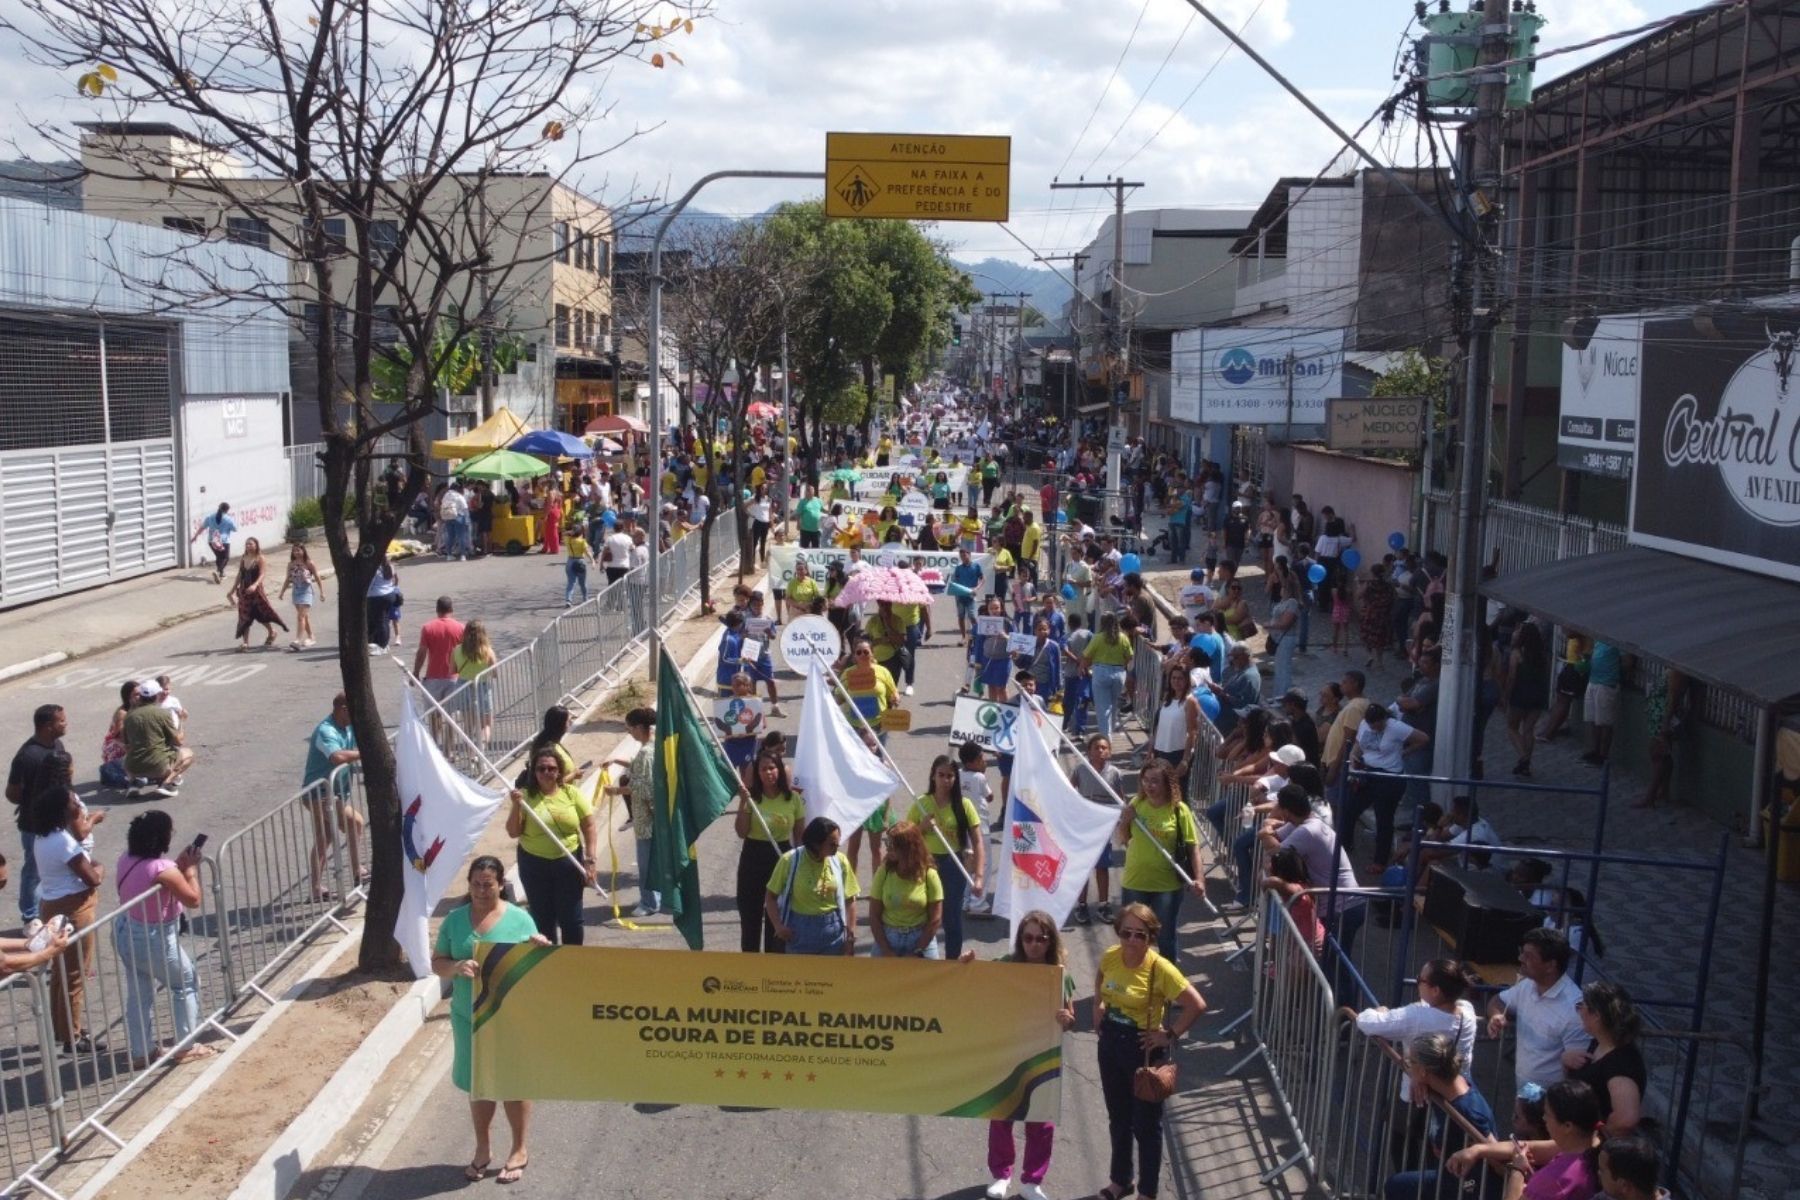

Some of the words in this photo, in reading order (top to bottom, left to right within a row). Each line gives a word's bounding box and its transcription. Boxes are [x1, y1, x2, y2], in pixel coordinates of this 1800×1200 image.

[911, 169, 927, 179] NA
[934, 170, 968, 180] FAIXA
[976, 171, 984, 181] A
[985, 187, 1001, 197] DO
[915, 201, 973, 212] PEDESTRE
[1603, 350, 1637, 376] NÚCLE
[1664, 394, 1780, 467] Central
[952, 730, 992, 745] SAÚDE
[592, 1004, 680, 1022] ESCOLA
[687, 1007, 812, 1027] MUNICIPAL
[818, 1012, 943, 1033] RAIMUNDA
[639, 1026, 718, 1043] COURA
[725, 1029, 756, 1045] DE
[762, 1031, 895, 1051] BARCELLOS
[645, 1049, 703, 1061] EDUCAÇÃO
[706, 1052, 806, 1064] TRANSFORMADORA
[808, 1055, 814, 1064] E
